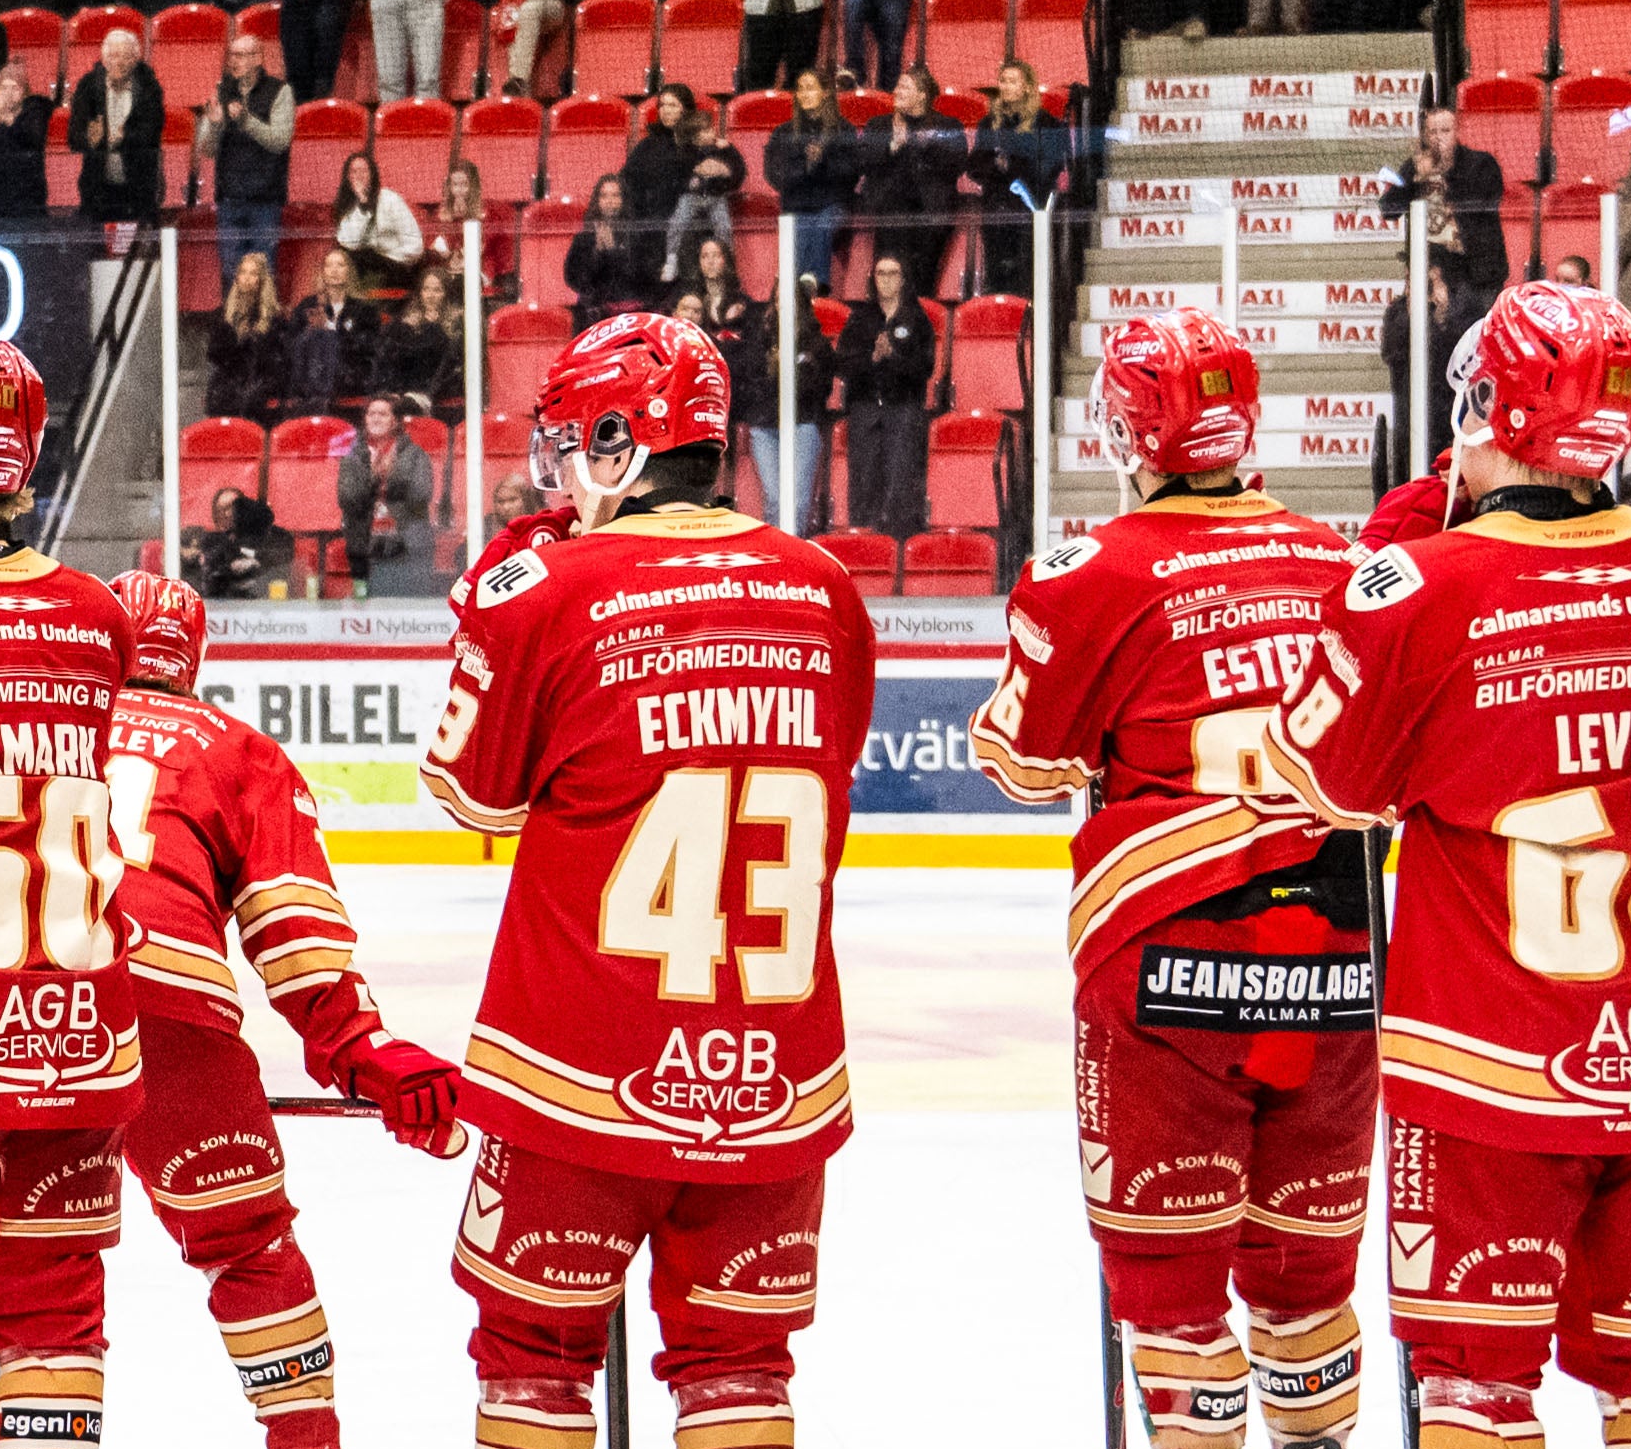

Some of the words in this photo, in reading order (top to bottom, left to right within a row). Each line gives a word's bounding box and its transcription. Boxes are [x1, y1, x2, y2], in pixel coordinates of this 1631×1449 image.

[1145, 82, 1210, 102] MAXI
[1249, 79, 1315, 100] MAXI
[1138, 114, 1203, 135] MAXI
[1243, 112, 1308, 132] MAXI
[1126, 182, 1191, 203] MAXI
[1119, 216, 1185, 238] MAXI
[1109, 288, 1176, 309] MAXI
[1305, 398, 1374, 419] MAXI
[1300, 436, 1369, 457] MAXI
[1152, 539, 1290, 579] Calmarsunds
[588, 579, 744, 622] Calmarsunds
[748, 577, 832, 609] Undertak
[1163, 584, 1227, 611] KALMAR
[376, 618, 452, 637] Nybloms
[894, 614, 976, 638] Nybloms
[1468, 593, 1622, 641] Calmarsunds
[43, 623, 112, 651] Undertak
[594, 623, 666, 653] KALMAR
[600, 640, 804, 688] BILFÖRMEDLING
[806, 651, 832, 676] AB
[1474, 644, 1545, 672] KALMAR
[91, 685, 111, 709] AB
[258, 684, 417, 745] BILEL
[636, 686, 823, 756] ECKMYHL
[597, 767, 830, 1005] 43
[1238, 1006, 1321, 1023] KALMAR
[654, 1028, 776, 1083] AGB
[652, 1080, 771, 1115] SERVICE
[1084, 1057, 1102, 1134] HAMN
[1122, 1170, 1156, 1207] KEITH
[1175, 1155, 1207, 1171] SON
[1406, 1122, 1424, 1212] HAMN
[503, 1230, 543, 1267] KEITH
[544, 1229, 560, 1244] &
[564, 1229, 601, 1247] SON
[542, 1265, 613, 1285] KALMAR
[1445, 1255, 1484, 1294] KEITH
[1506, 1238, 1543, 1255] SON
[3, 1408, 101, 1438] egenloka
